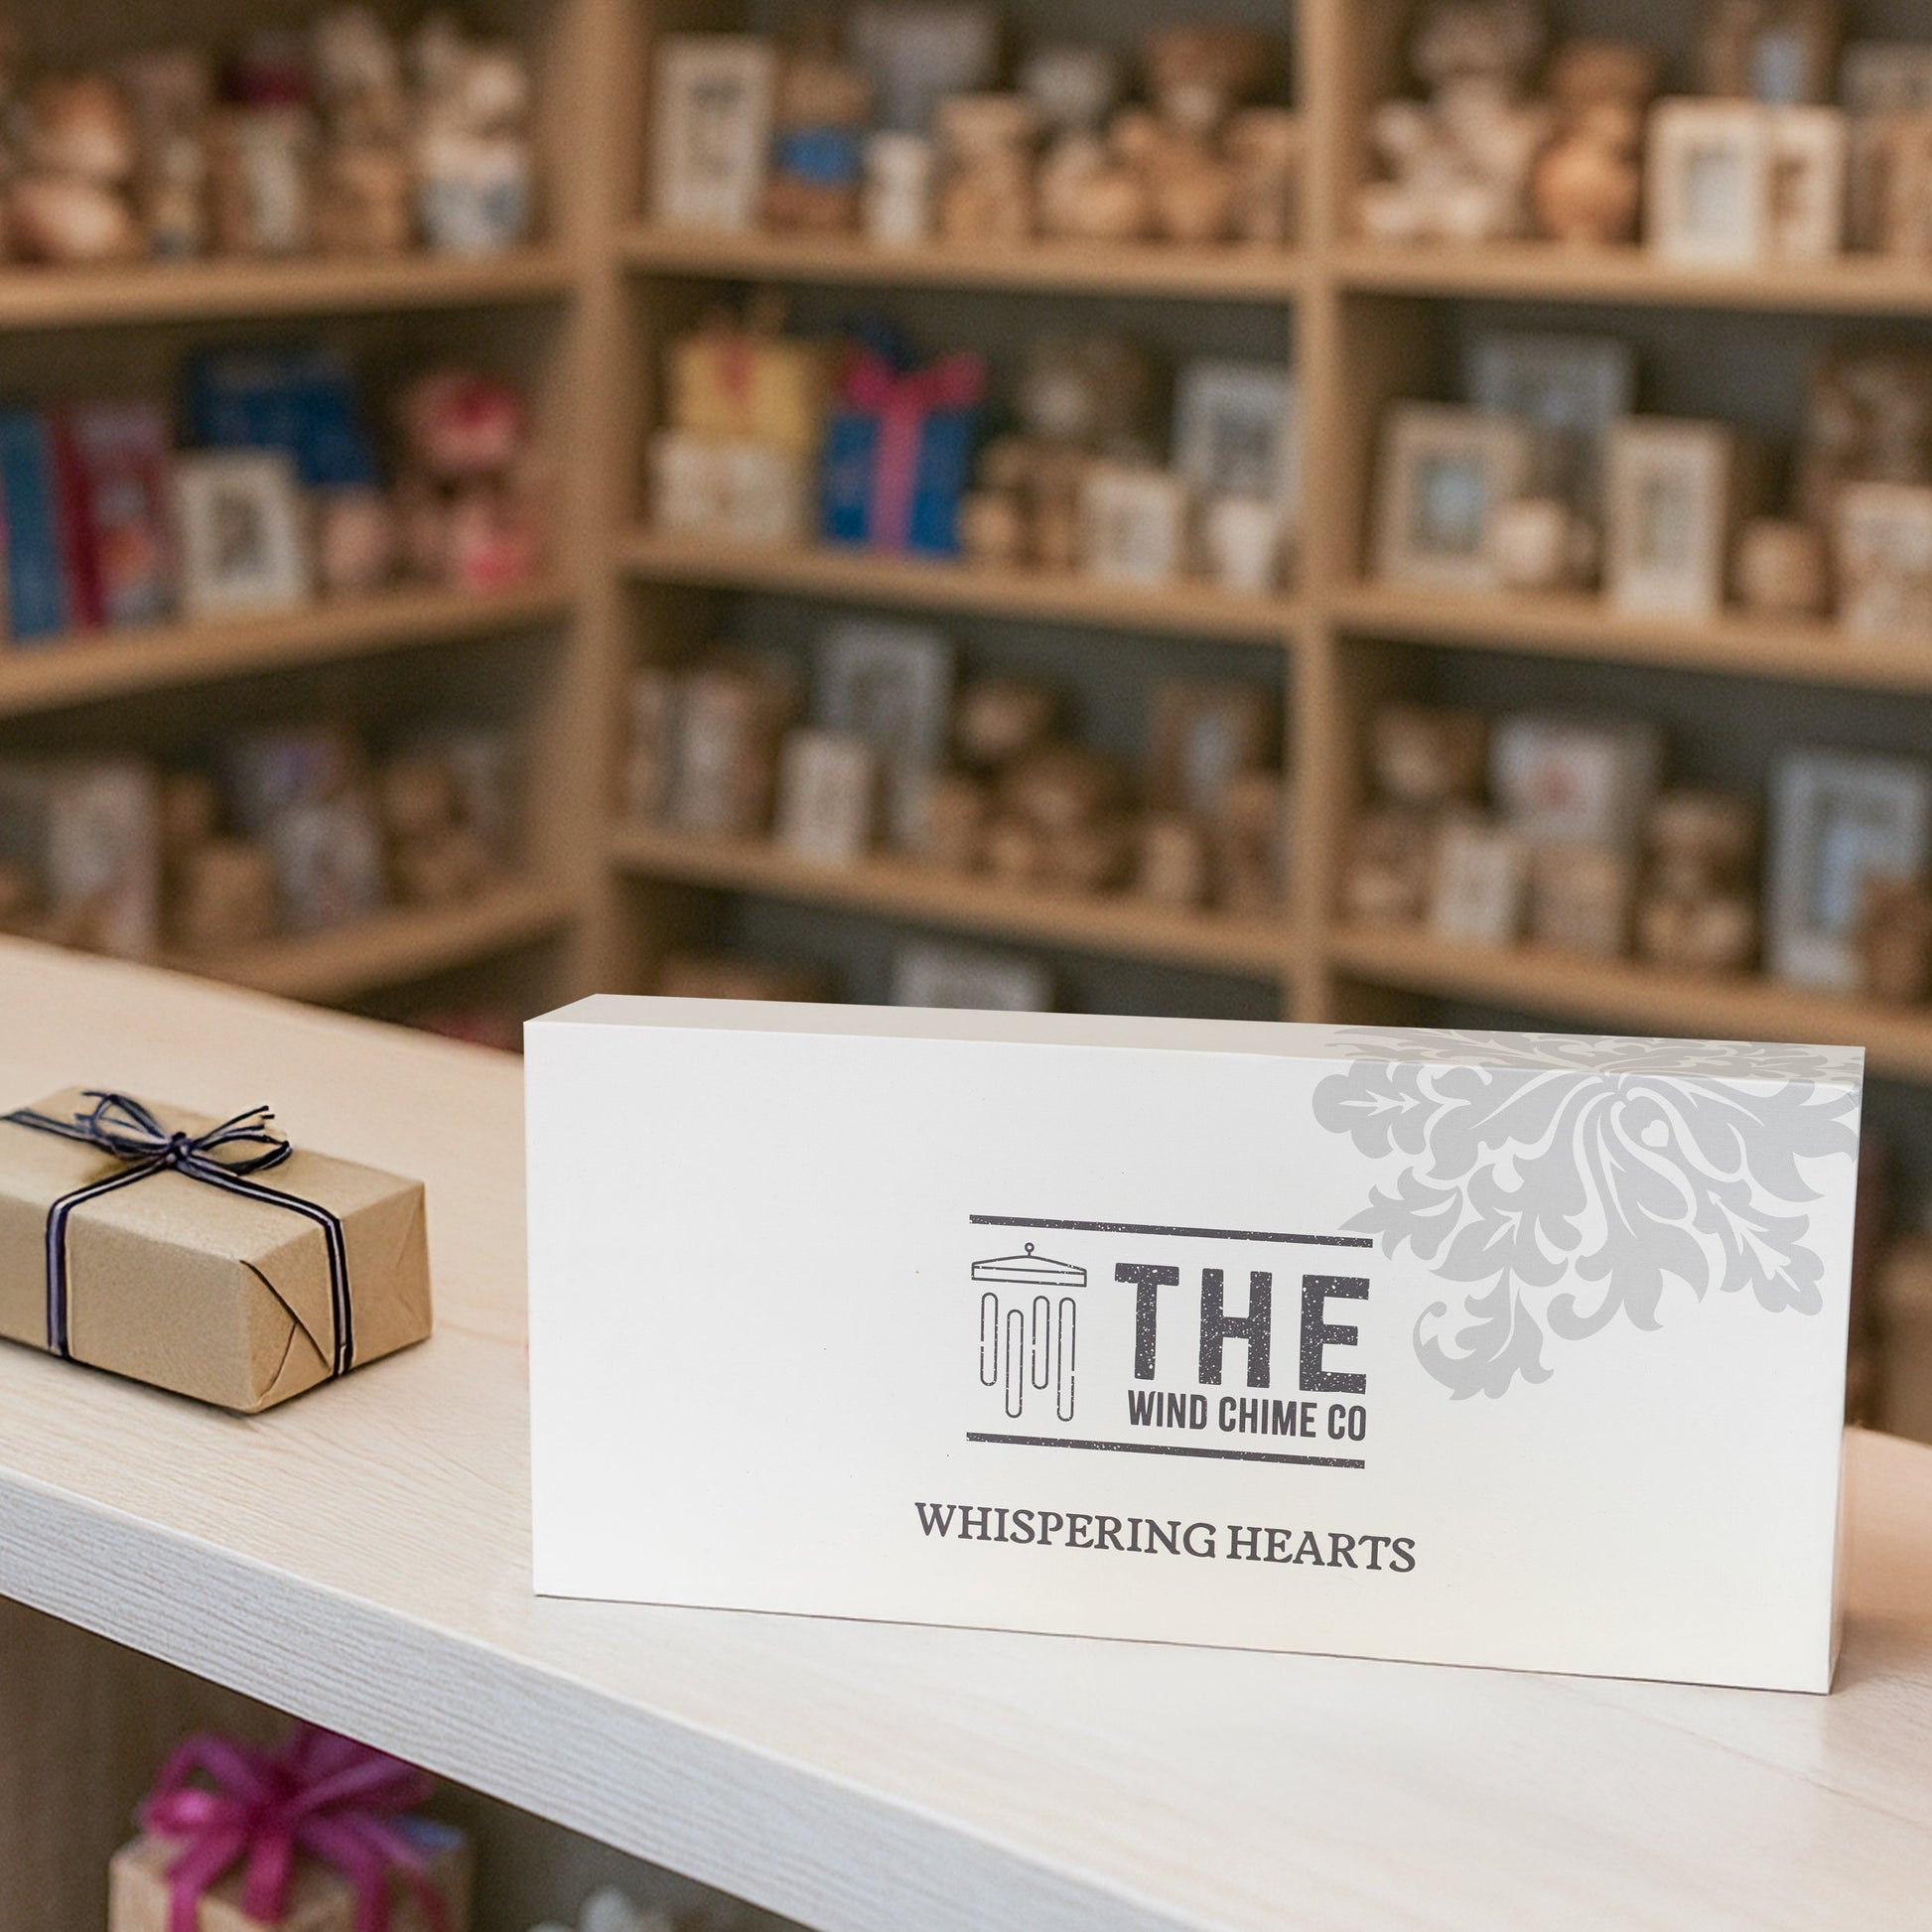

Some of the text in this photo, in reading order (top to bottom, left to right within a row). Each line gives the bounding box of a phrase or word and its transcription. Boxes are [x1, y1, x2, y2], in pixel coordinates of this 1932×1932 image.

[1115, 1263, 1369, 1394] THE
[1128, 1390, 1366, 1441] WIND CHIME CO
[915, 1502, 1415, 1572] WHISPERING HEARTS
